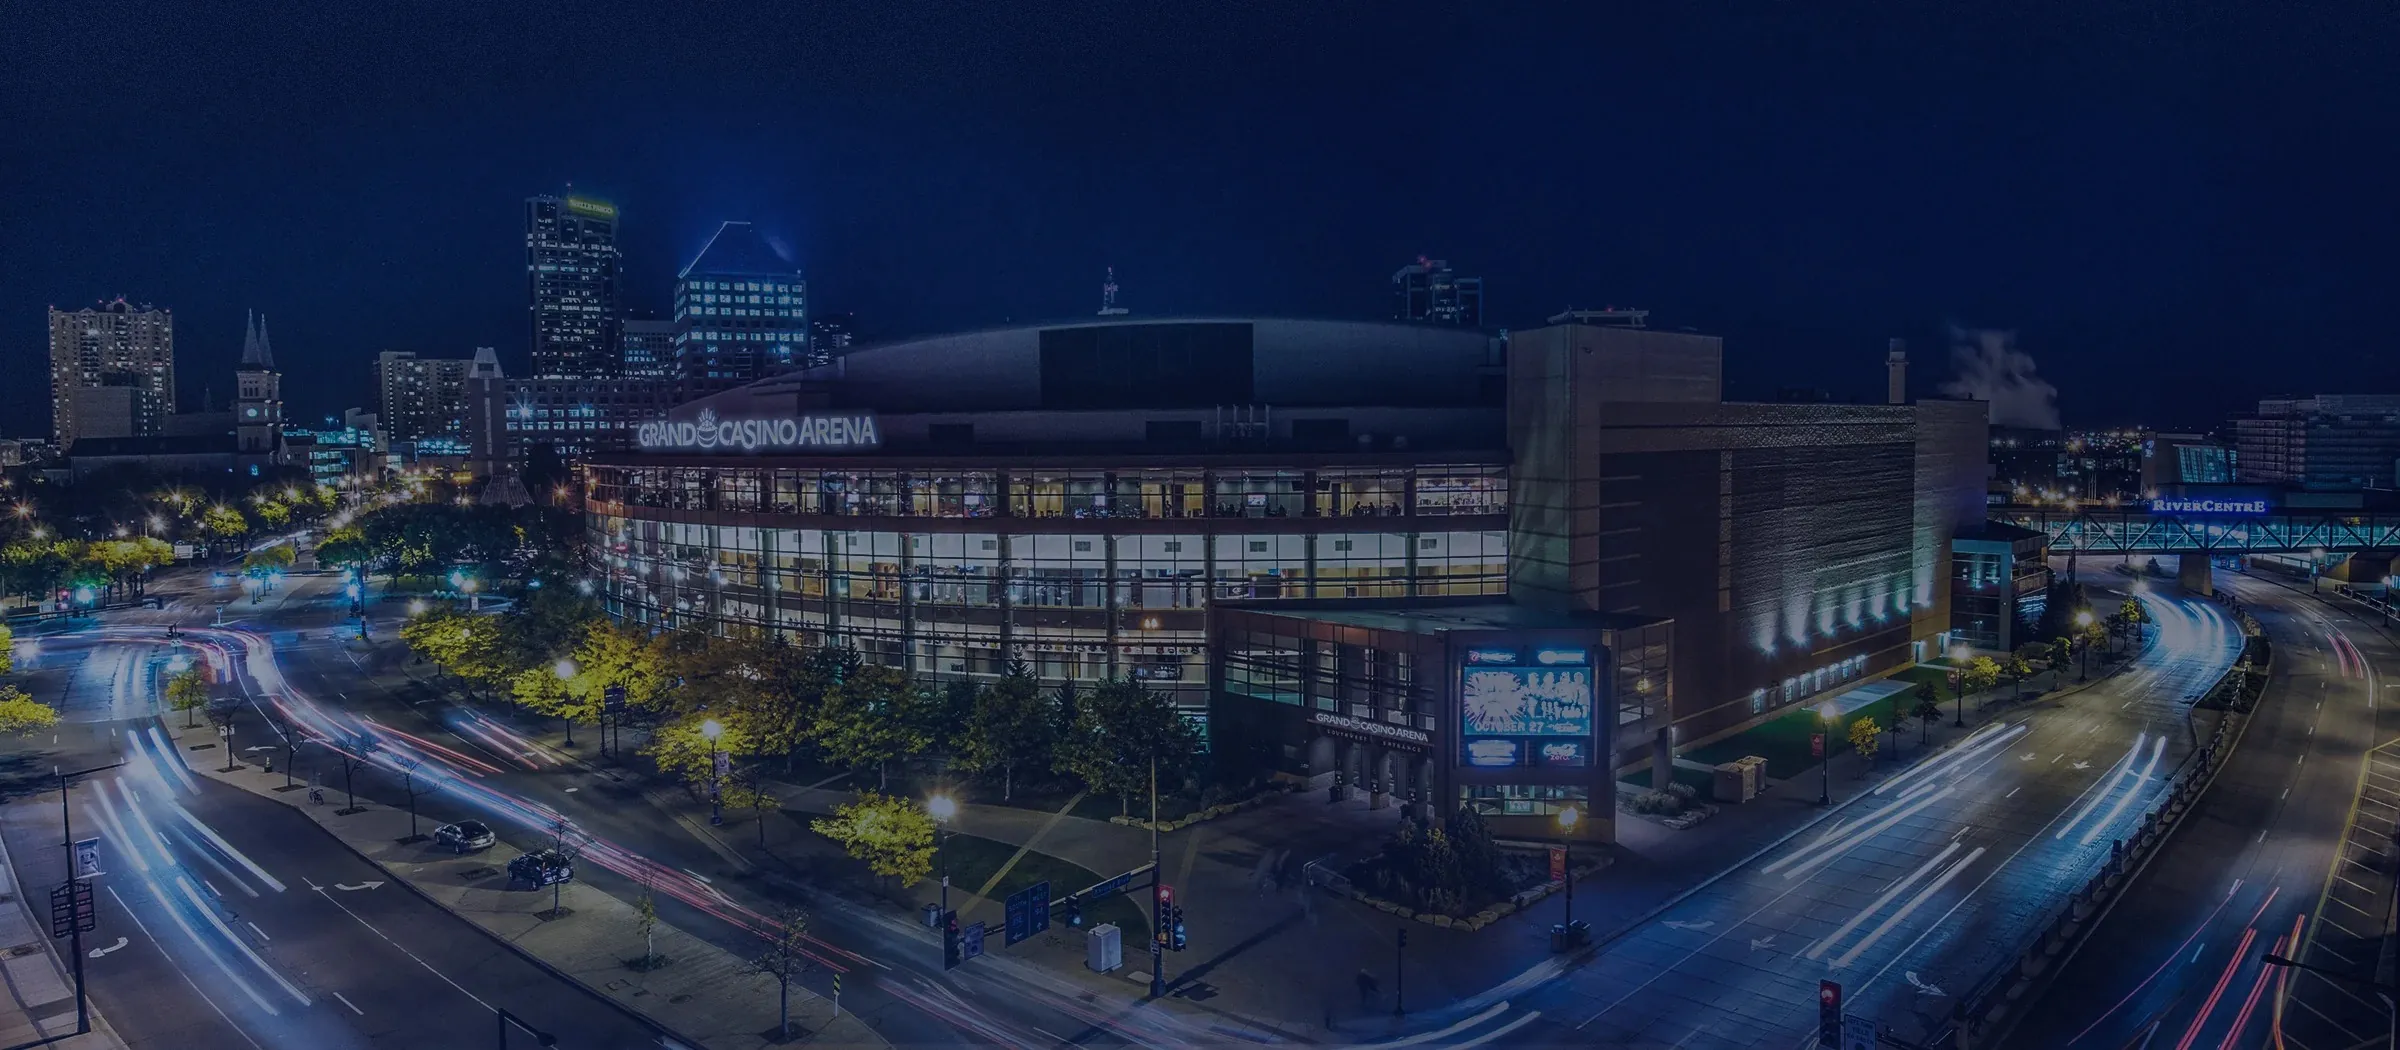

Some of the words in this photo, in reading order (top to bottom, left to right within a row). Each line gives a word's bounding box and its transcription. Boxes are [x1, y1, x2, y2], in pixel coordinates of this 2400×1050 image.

[639, 420, 697, 447] GRAND
[718, 419, 798, 450] CASINO
[799, 416, 877, 445] ARENA
[1316, 713, 1351, 727] GRAND
[1360, 721, 1396, 735] CASINO
[1396, 727, 1429, 742] ARENA
[1474, 721, 1526, 733] OCTOBER
[1529, 721, 1545, 733] 27
